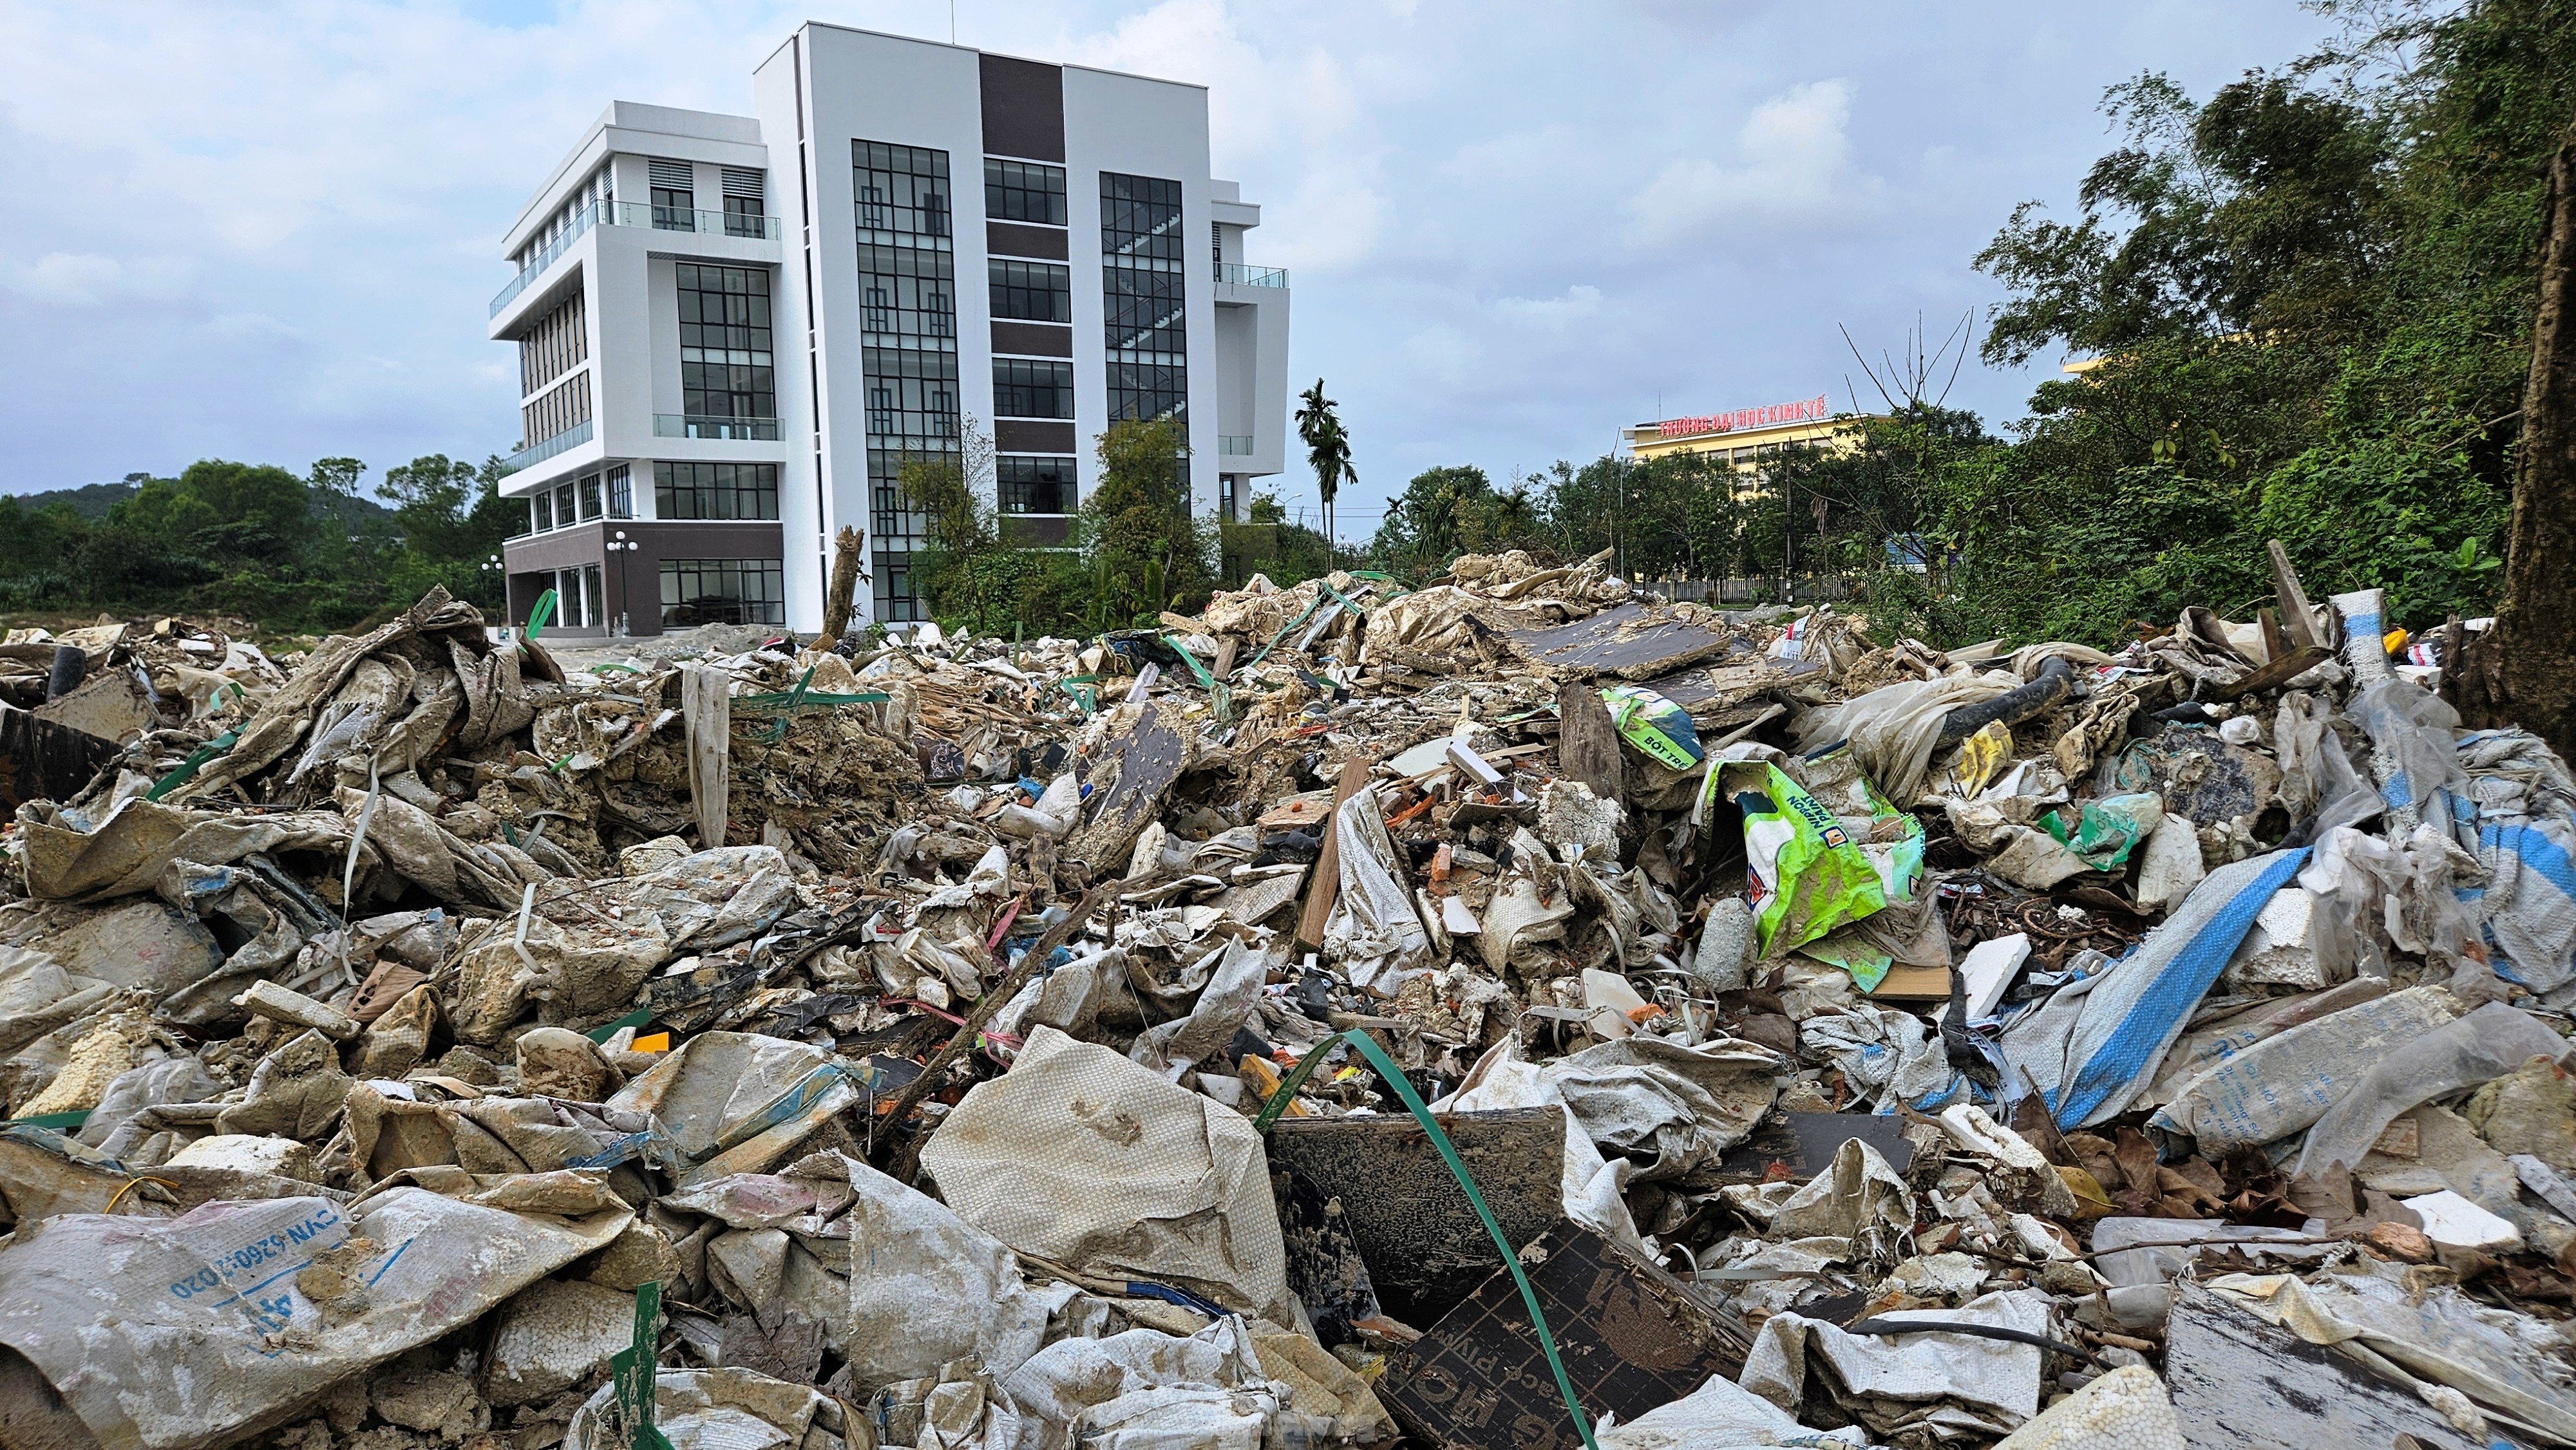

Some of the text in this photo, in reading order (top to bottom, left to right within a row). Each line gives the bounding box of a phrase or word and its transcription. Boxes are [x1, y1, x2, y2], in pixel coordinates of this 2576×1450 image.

[1660, 393, 1826, 437] TRƯỜNG ĐẠI HỌC KINH TẾ
[1643, 736, 1669, 754] BỘT
[1786, 795, 1824, 829] NIPPON
[1801, 795, 1831, 822] PAINT
[2248, 1120, 2262, 1136] Số
